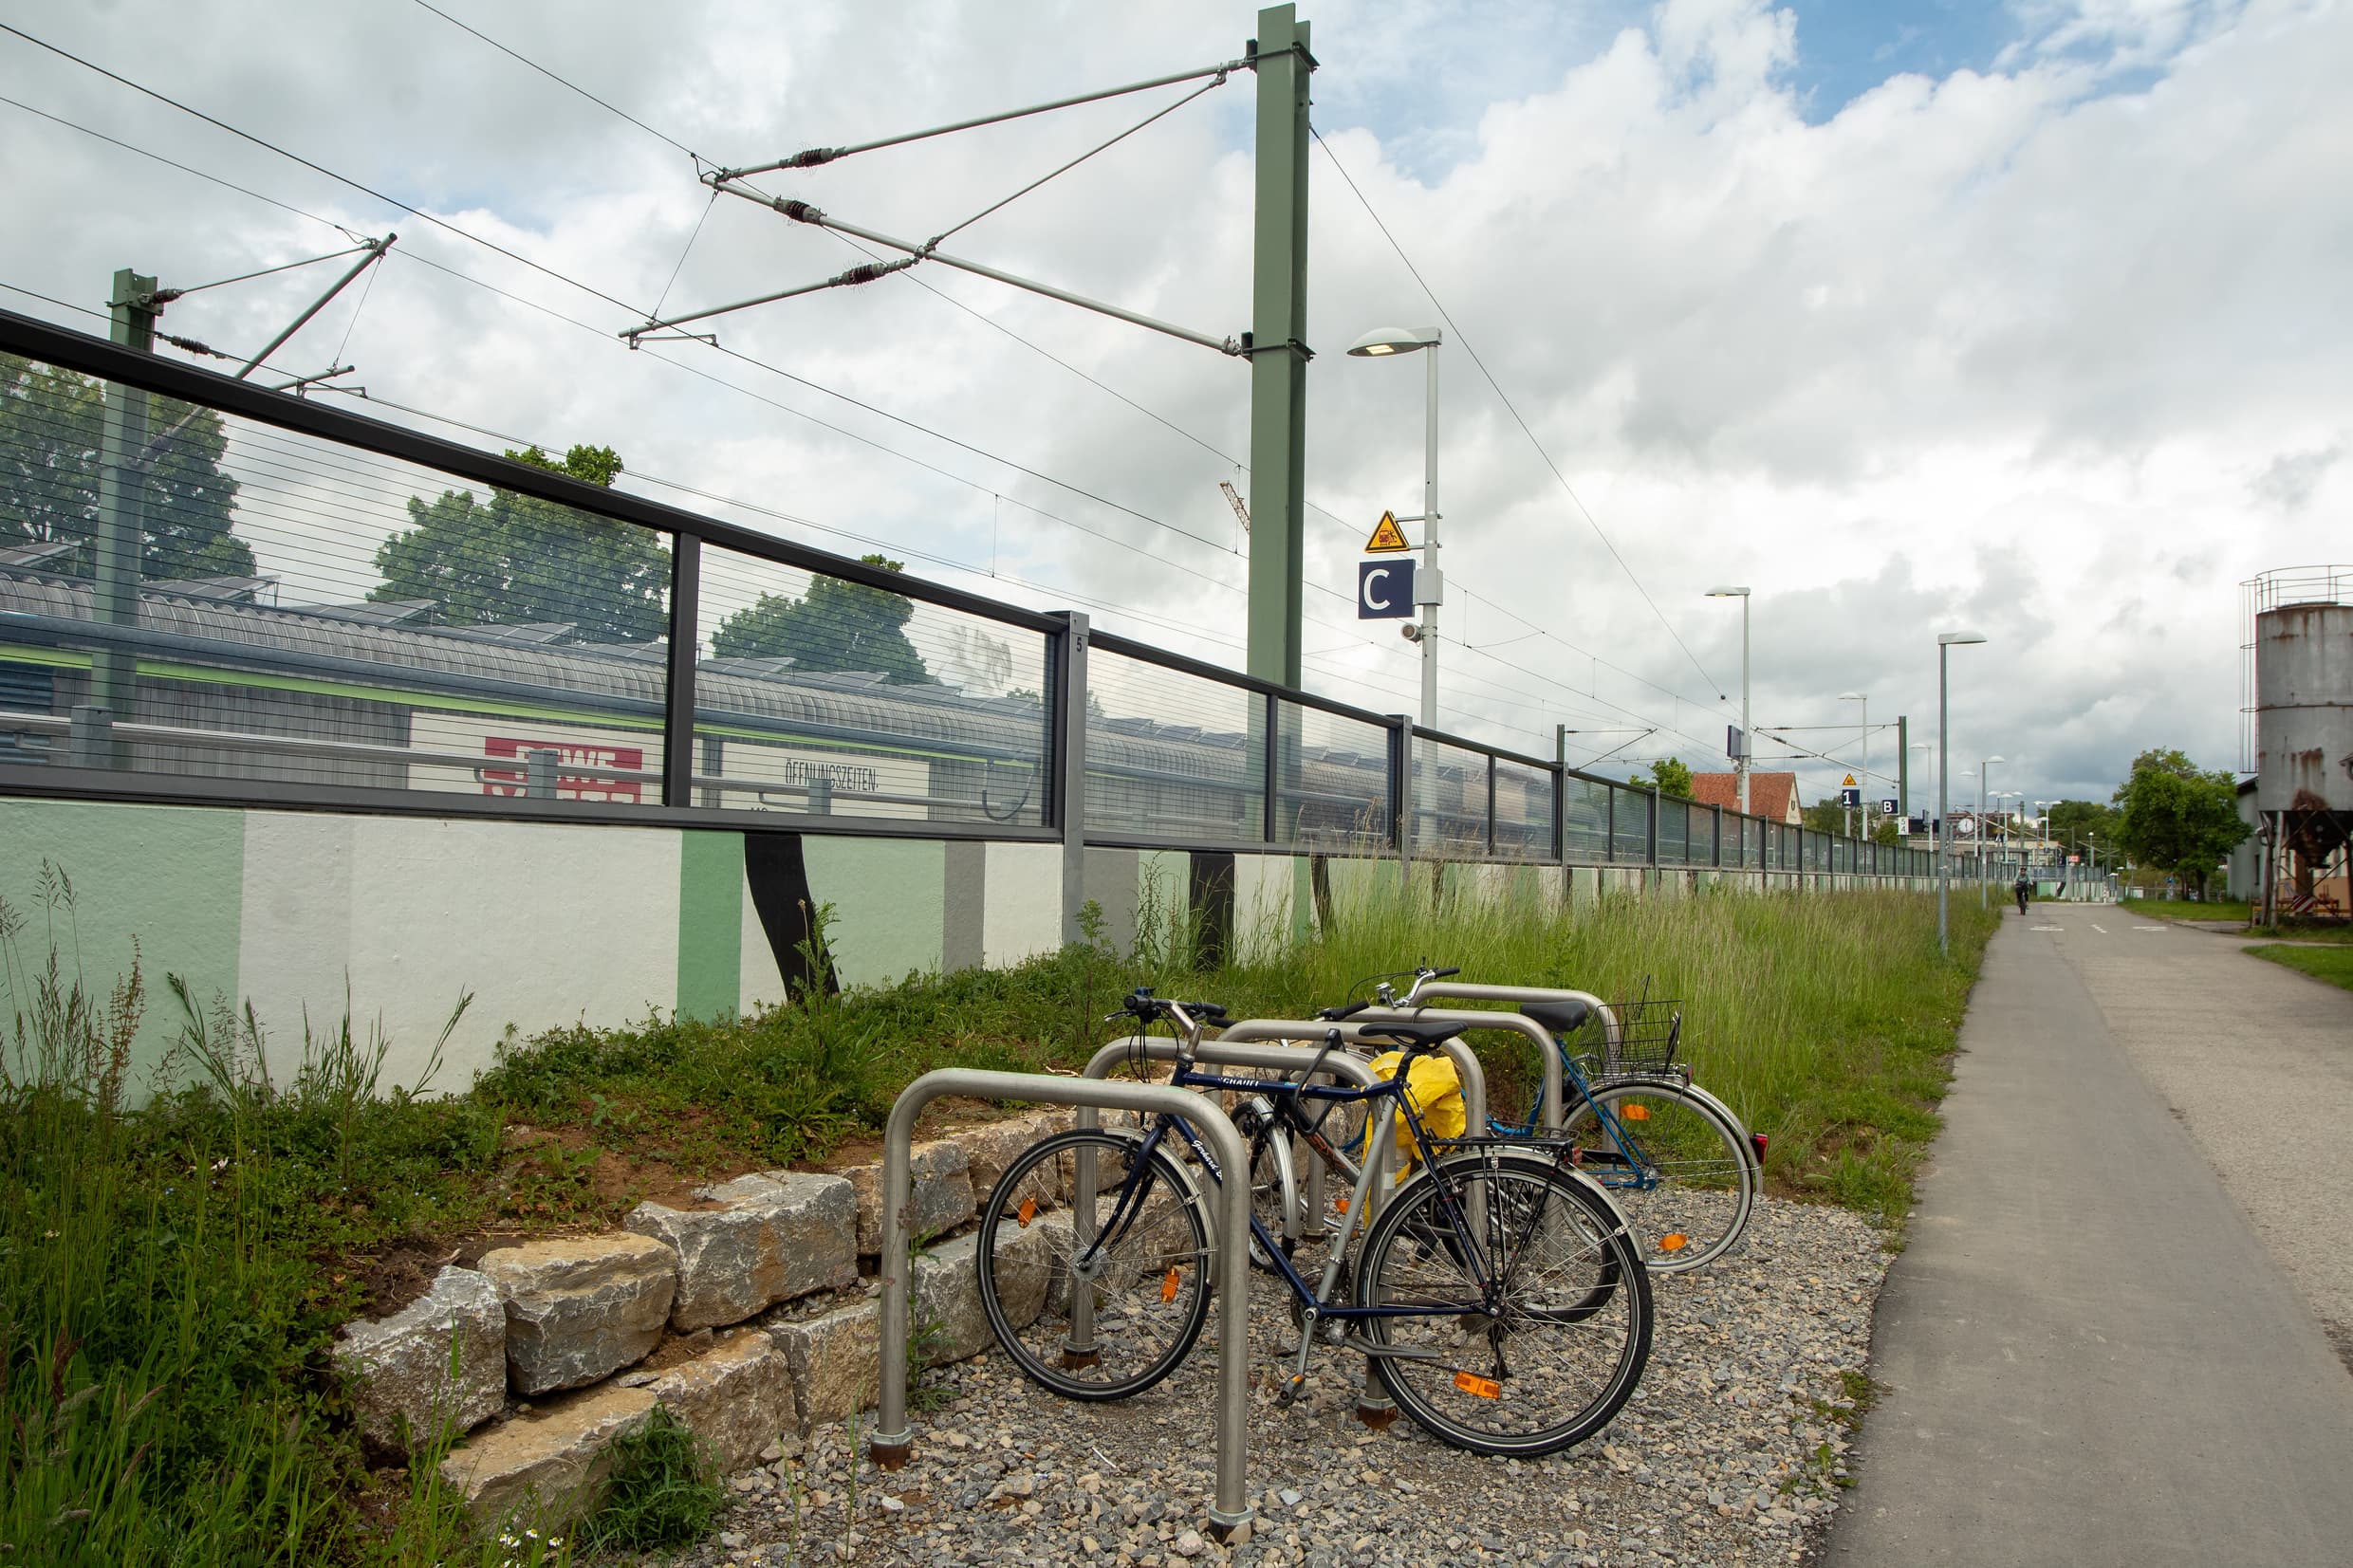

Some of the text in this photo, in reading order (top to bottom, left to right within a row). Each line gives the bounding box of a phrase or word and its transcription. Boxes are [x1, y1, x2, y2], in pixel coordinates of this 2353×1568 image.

[1363, 568, 1391, 611] C
[1076, 636, 1083, 653] 5
[1843, 791, 1852, 804] 1
[1883, 801, 1893, 813] B
